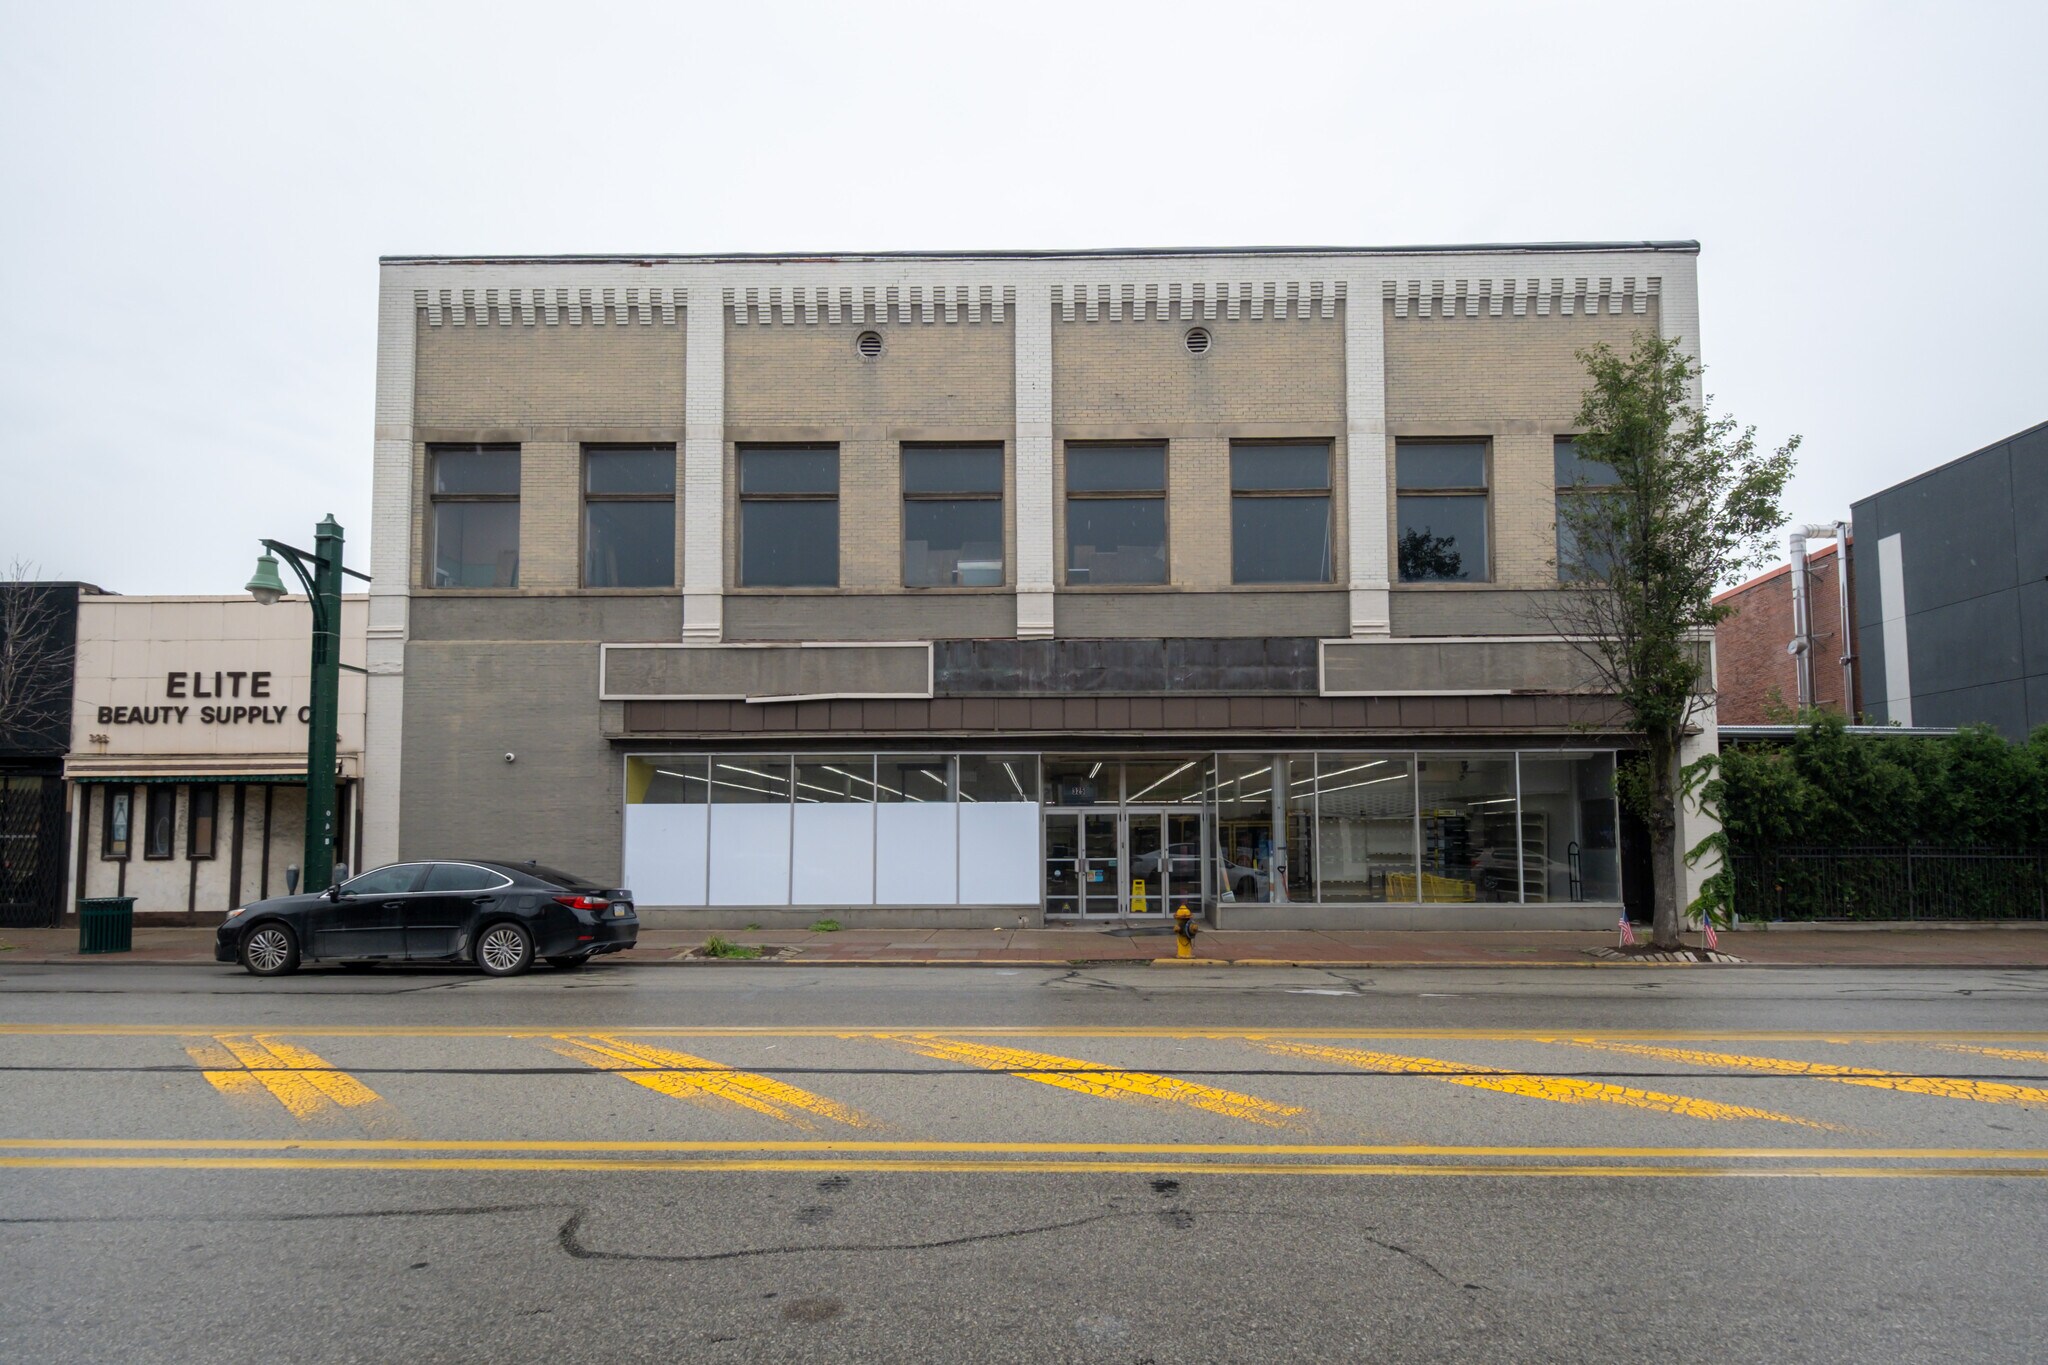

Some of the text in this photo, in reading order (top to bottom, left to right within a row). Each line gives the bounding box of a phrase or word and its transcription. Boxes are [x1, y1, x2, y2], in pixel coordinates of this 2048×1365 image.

[167, 671, 271, 698] ELITE
[97, 705, 189, 724] BEAUTY
[200, 705, 287, 724] SUPPLY
